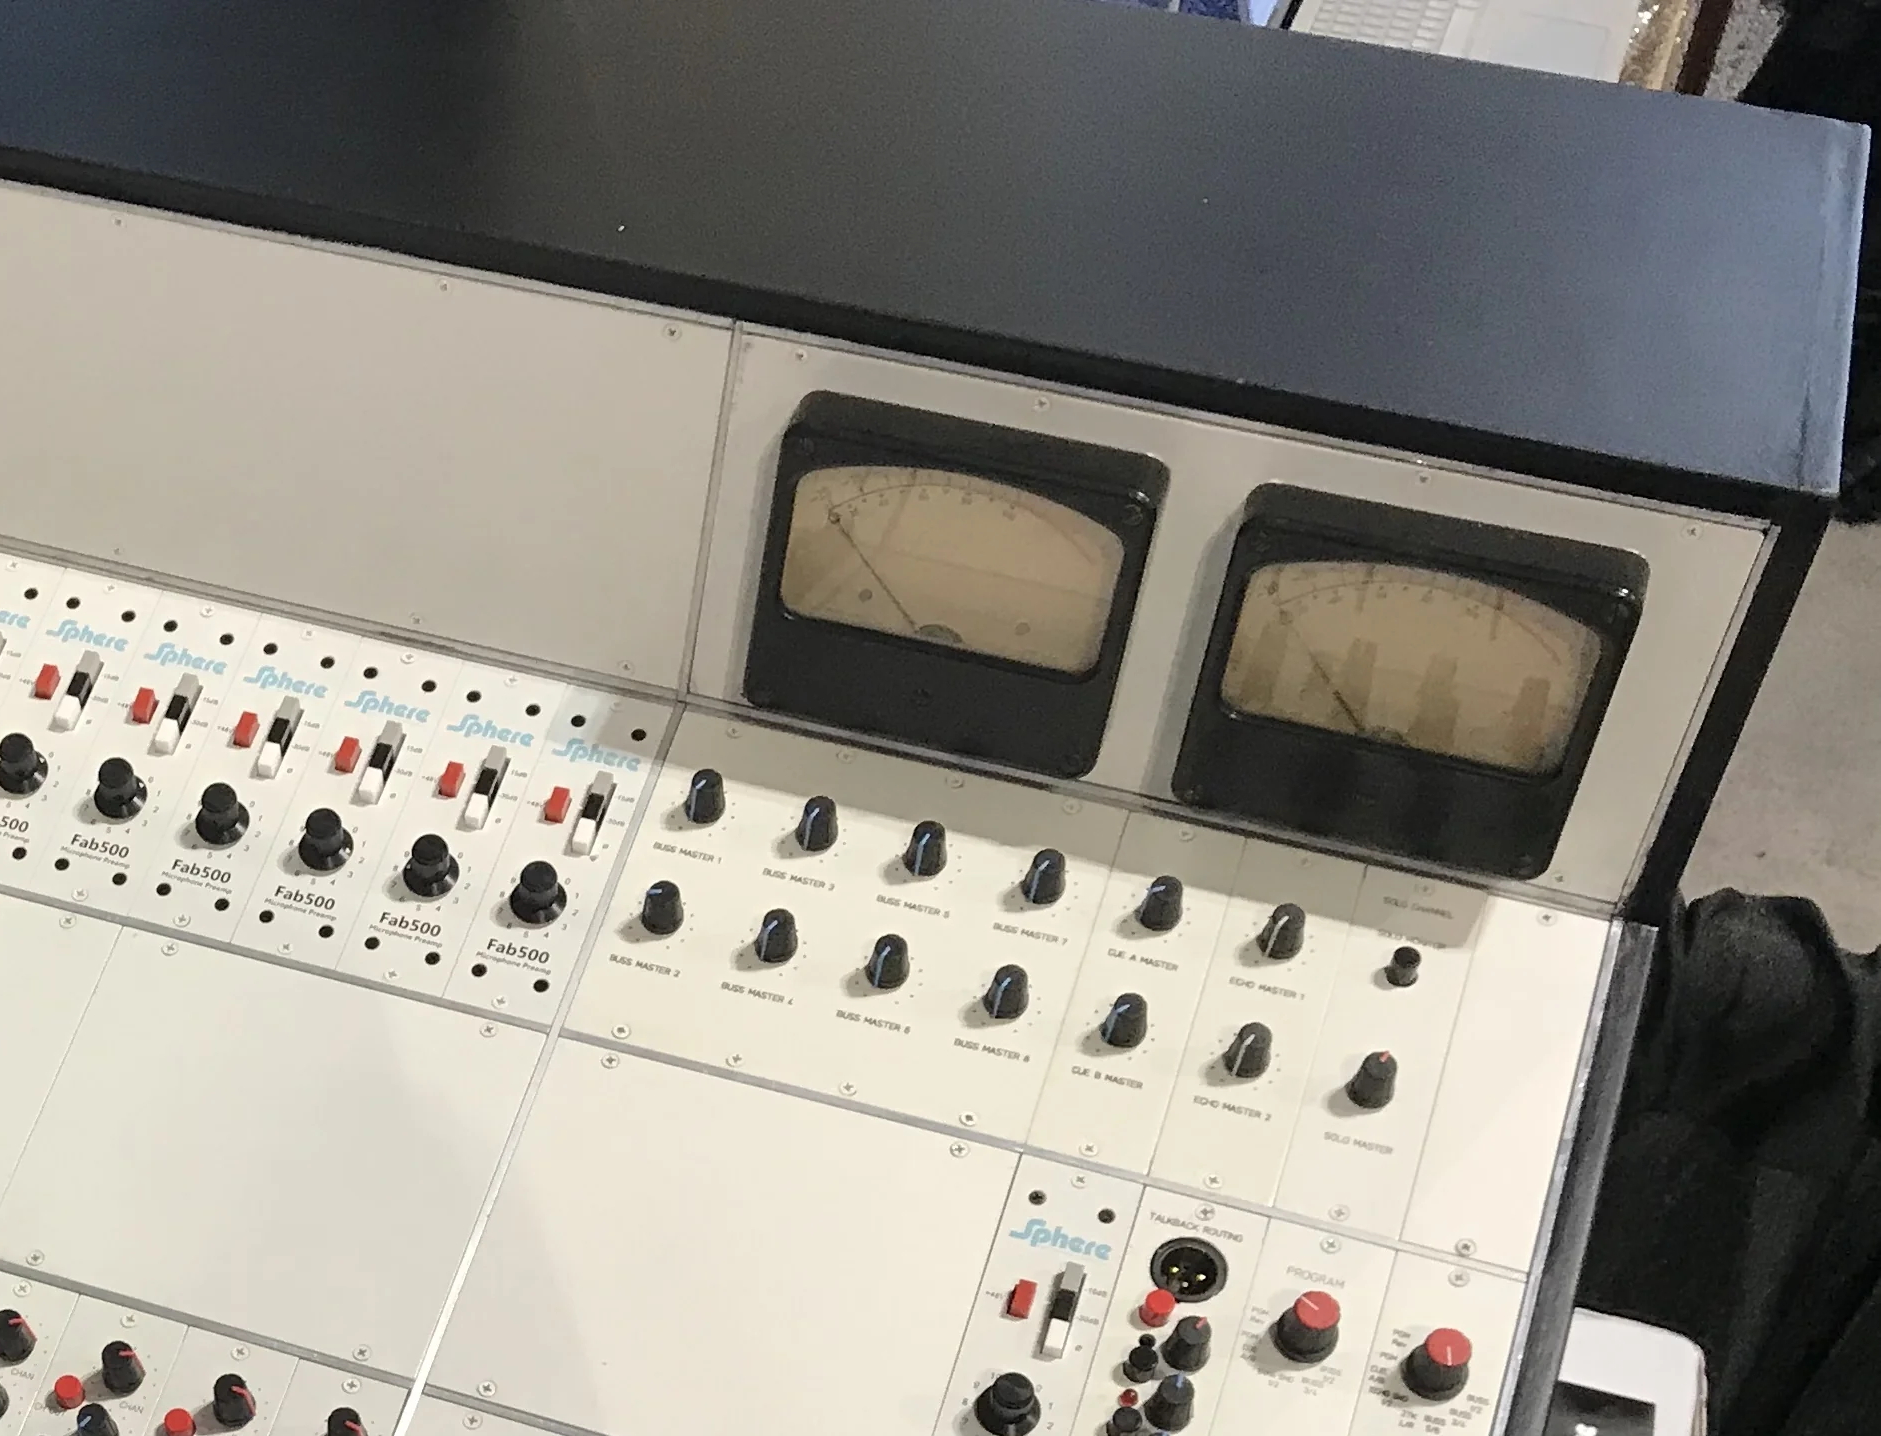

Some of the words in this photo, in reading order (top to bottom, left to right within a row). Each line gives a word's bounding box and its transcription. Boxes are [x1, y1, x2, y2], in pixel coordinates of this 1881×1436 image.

[46, 618, 129, 652] Sphere
[143, 642, 227, 675] Sphere
[243, 665, 328, 699] Sphere
[344, 689, 430, 723] Sphere
[446, 713, 535, 748] Sphere
[551, 738, 641, 772] Sphere
[70, 834, 130, 860] Fab500
[653, 841, 677, 853] BUSS
[679, 848, 714, 862] MASTER
[171, 858, 232, 884] Fab500
[763, 868, 787, 880] BUSS
[790, 874, 825, 888] MASTER
[274, 884, 336, 911] Fab500
[876, 895, 901, 906] BUSS
[903, 902, 941, 916] MASTER
[379, 910, 443, 938] Fab500
[993, 923, 1019, 934] BUSS
[1021, 929, 1059, 943] MASTER
[486, 937, 550, 964] Fab500
[1108, 948, 1126, 959] CUE
[1140, 957, 1178, 971] MASTER
[609, 954, 633, 966] BUSS
[635, 960, 671, 975] MASTER
[721, 982, 745, 993] BUSS
[748, 988, 785, 1003] MASTER
[1229, 976, 1255, 989] ECHO
[1258, 984, 1297, 998] MASTER
[836, 1010, 861, 1021] BUSS
[864, 1017, 901, 1031] MASTER
[954, 1038, 980, 1050] BUSS
[982, 1045, 1020, 1060] MASTER
[1071, 1066, 1090, 1077] CUE
[1104, 1074, 1143, 1089] MASTER
[1193, 1096, 1220, 1108] ECHO
[1222, 1103, 1262, 1118] MASTER
[1324, 1132, 1350, 1144] SOLO
[1353, 1139, 1393, 1154] MASTER
[1009, 1218, 1112, 1260] Sphere
[1149, 1211, 1200, 1232] TALKBACK
[1202, 1225, 1244, 1243] ROUTING
[1286, 1265, 1346, 1289] PROGRAM
